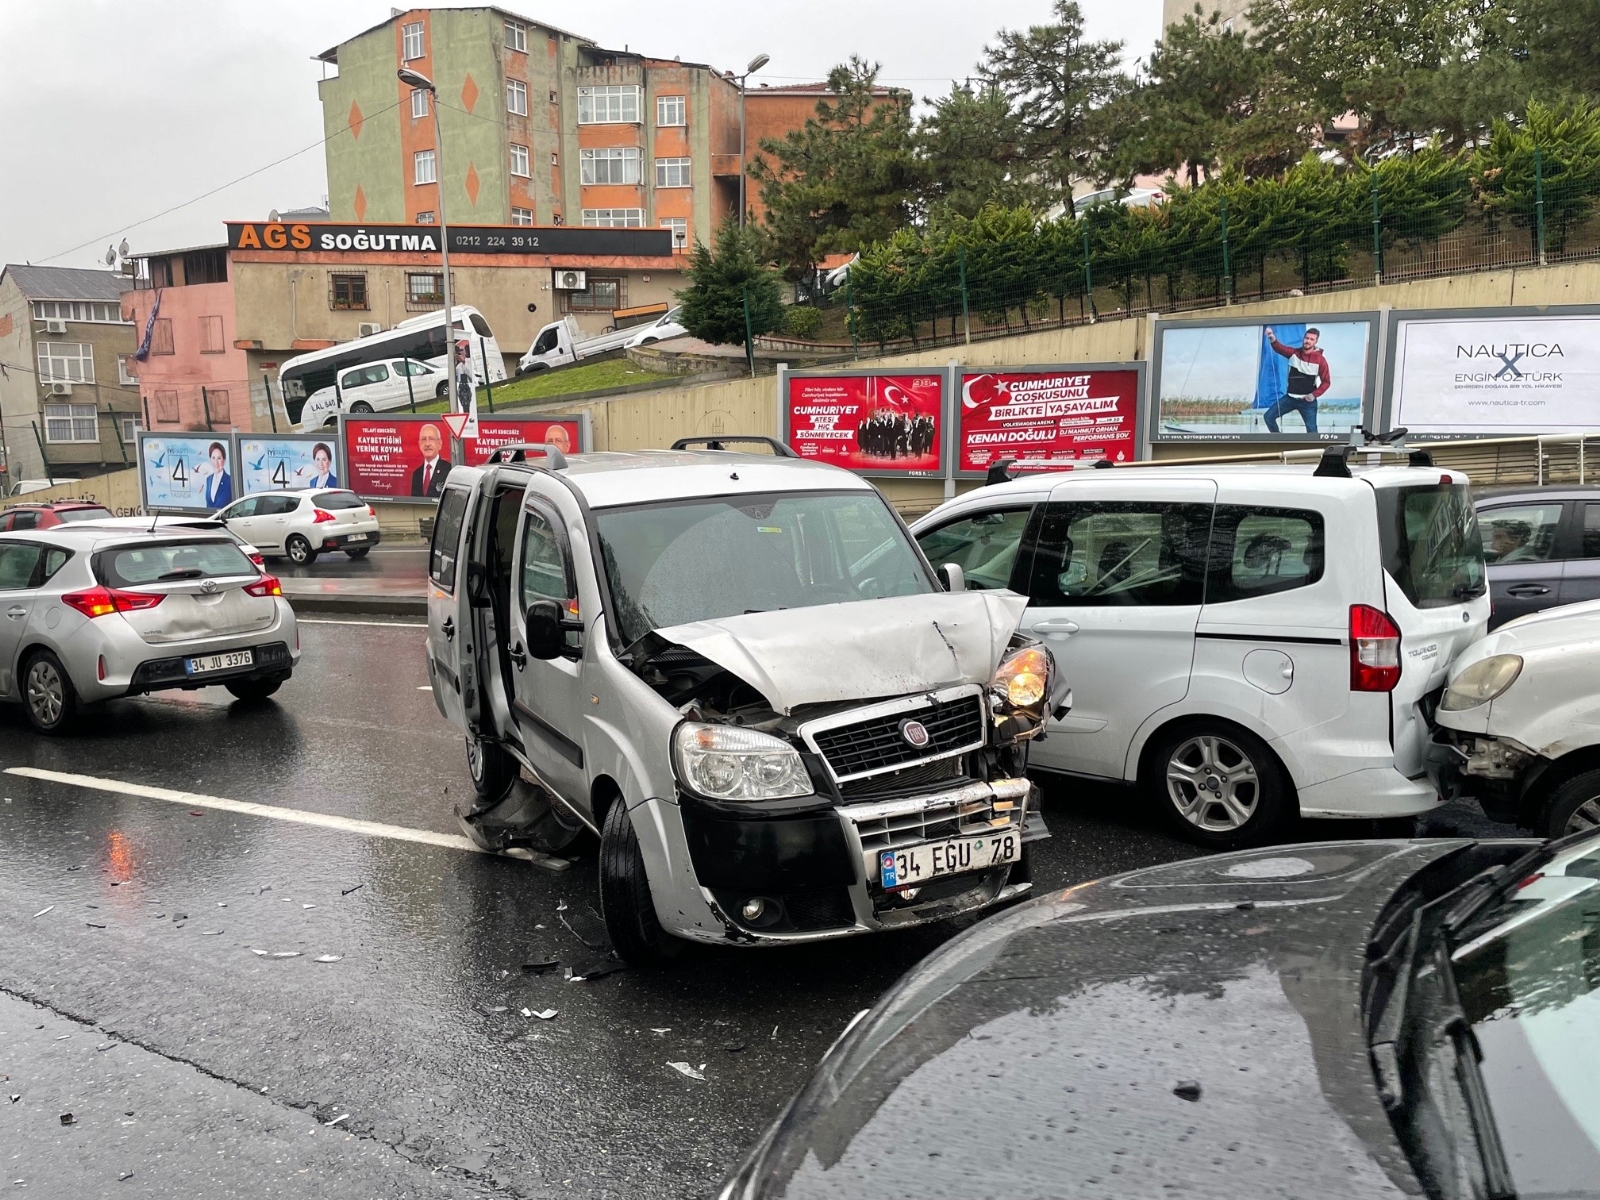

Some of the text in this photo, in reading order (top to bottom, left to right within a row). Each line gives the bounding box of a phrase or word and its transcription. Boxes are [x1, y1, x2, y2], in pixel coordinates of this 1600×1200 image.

[238, 224, 539, 250] AGS SOĞUTMA 0212 224 39 12
[1457, 343, 1564, 358] NAUTICA
[1493, 352, 1525, 378] X
[1010, 375, 1091, 391] CUMHURİYET
[1454, 370, 1563, 382] ENGİN ÖZTÜRK
[1014, 388, 1085, 402] COŞKUSUNU
[793, 405, 859, 415] CUMHURİYET
[994, 400, 1114, 418] BİRLİKTE YAŞAYALIM
[817, 423, 830, 431] HİÇ
[357, 436, 402, 445] KAYBETTİĞİNİ
[967, 428, 1056, 444] KENAN DOĞULU
[355, 445, 403, 454] YERİNE KOYMA
[371, 453, 389, 462] VAKTİ
[172, 457, 189, 488] 4
[271, 458, 290, 488] 4
[191, 651, 251, 672] 34 JU 3376
[896, 851, 921, 880] 34
[991, 836, 1014, 863] 78
[885, 872, 895, 880] TR
